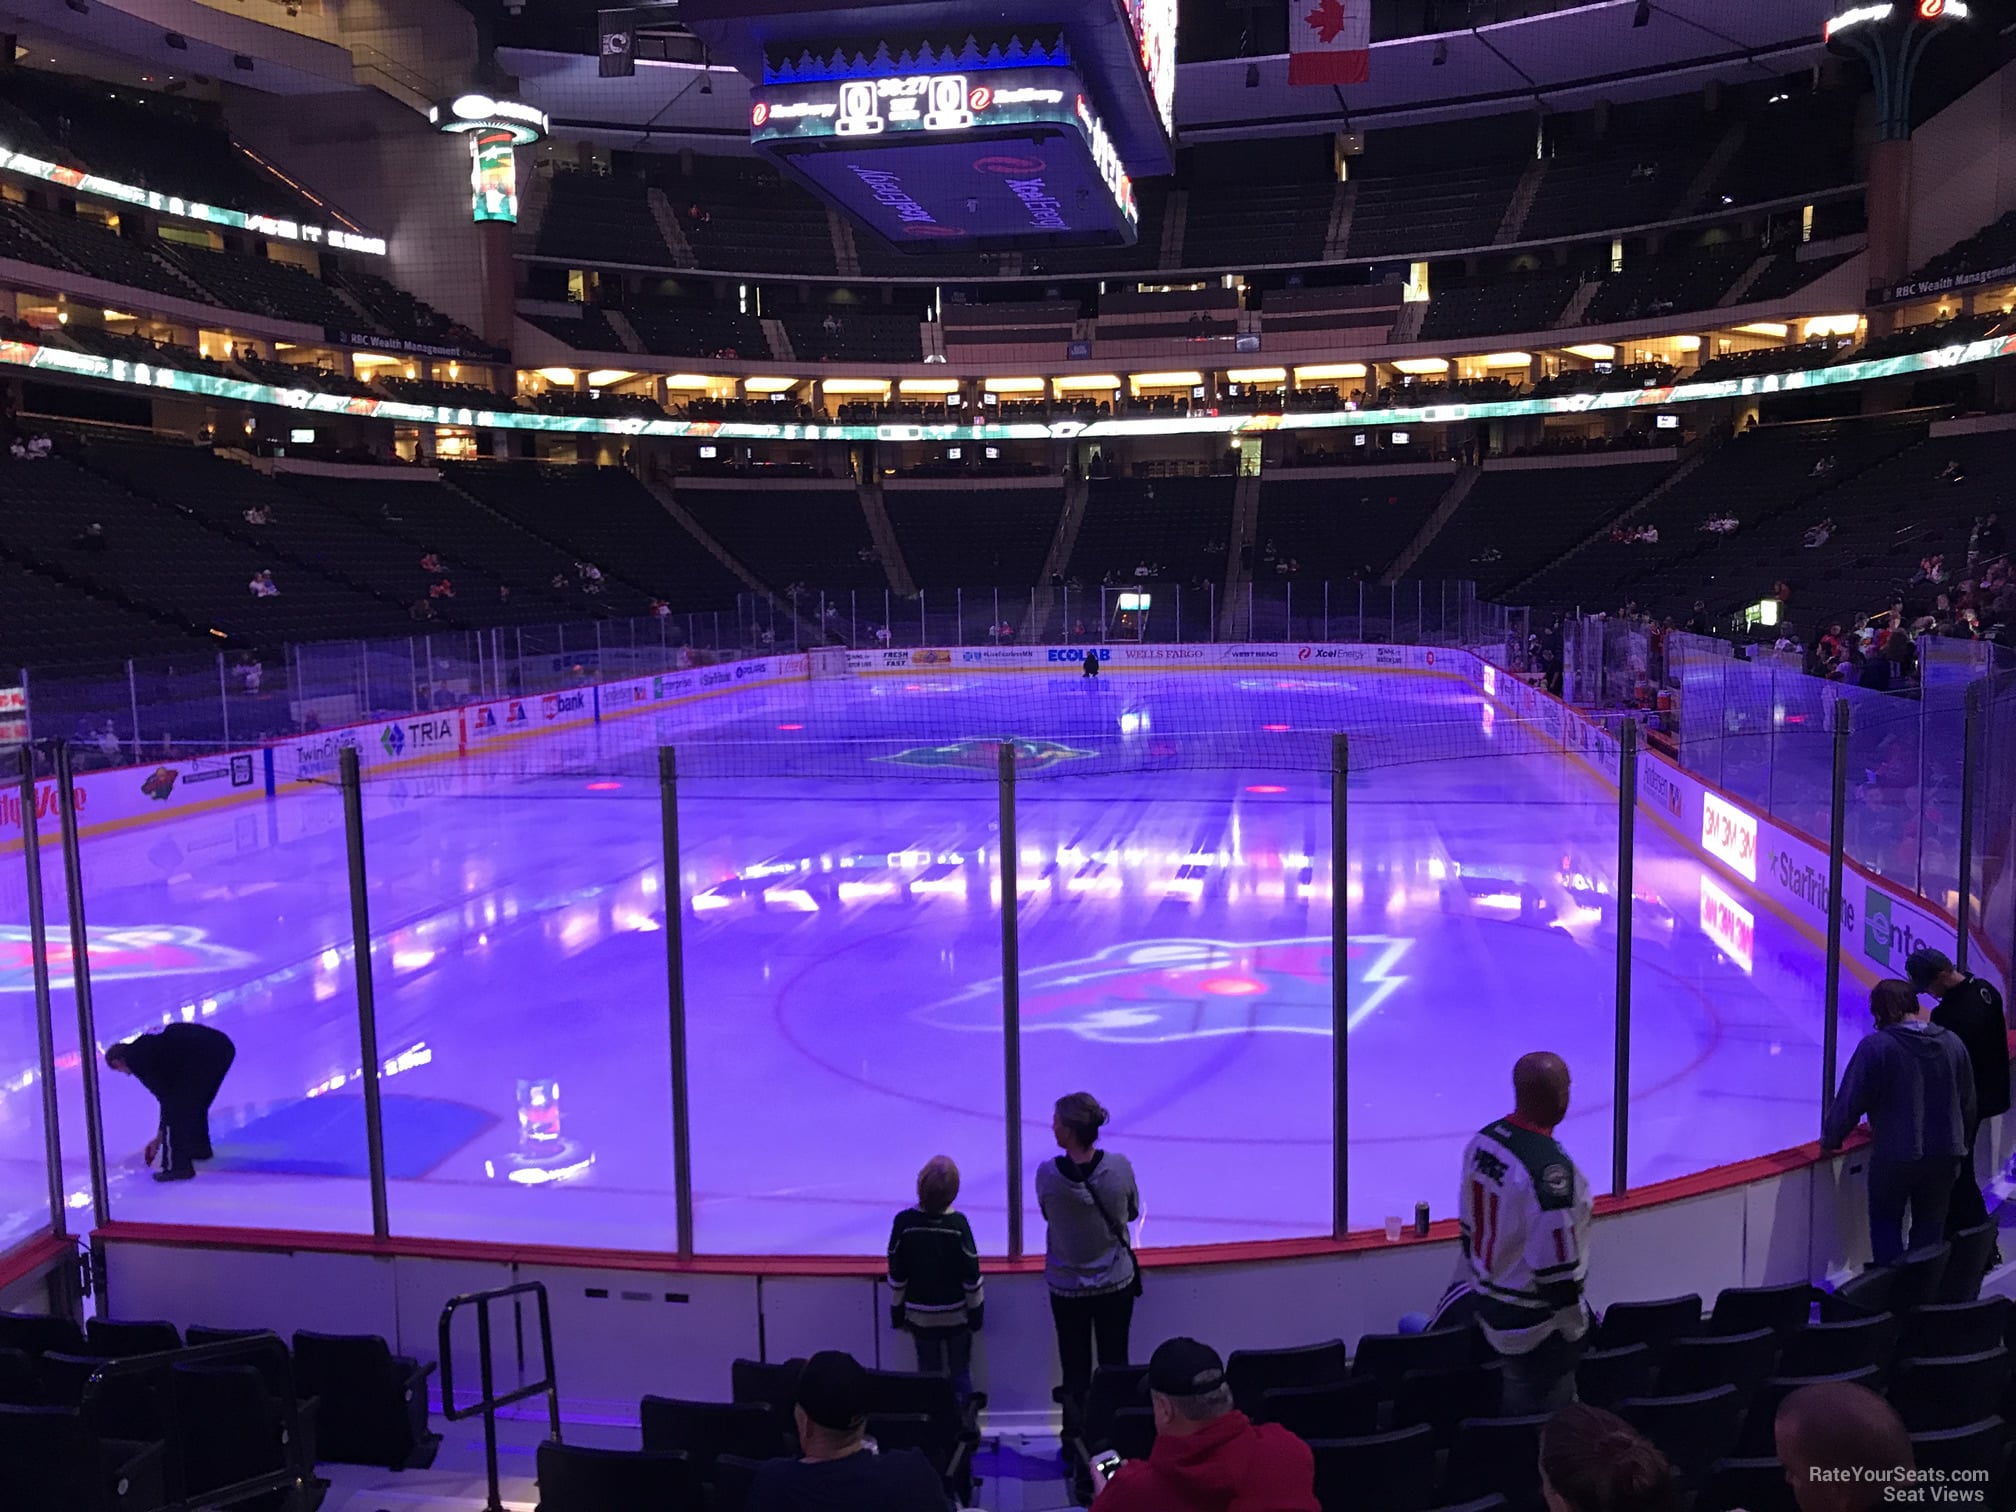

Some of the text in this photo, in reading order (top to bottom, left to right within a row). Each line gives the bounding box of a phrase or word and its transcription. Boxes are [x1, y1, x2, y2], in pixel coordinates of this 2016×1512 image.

[1895, 284, 1917, 298] RBC
[1917, 278, 1954, 293] Wealth
[351, 332, 369, 346] RBC
[370, 336, 402, 350] Wealth
[404, 341, 460, 357] Management
[883, 651, 908, 659] FRESH
[886, 659, 906, 668] FAST
[1125, 649, 1204, 659] WELLS FARGO
[408, 718, 453, 748] TRIA
[1704, 805, 1757, 860] 3M 3M 3M
[1780, 852, 1855, 932] StarTribne
